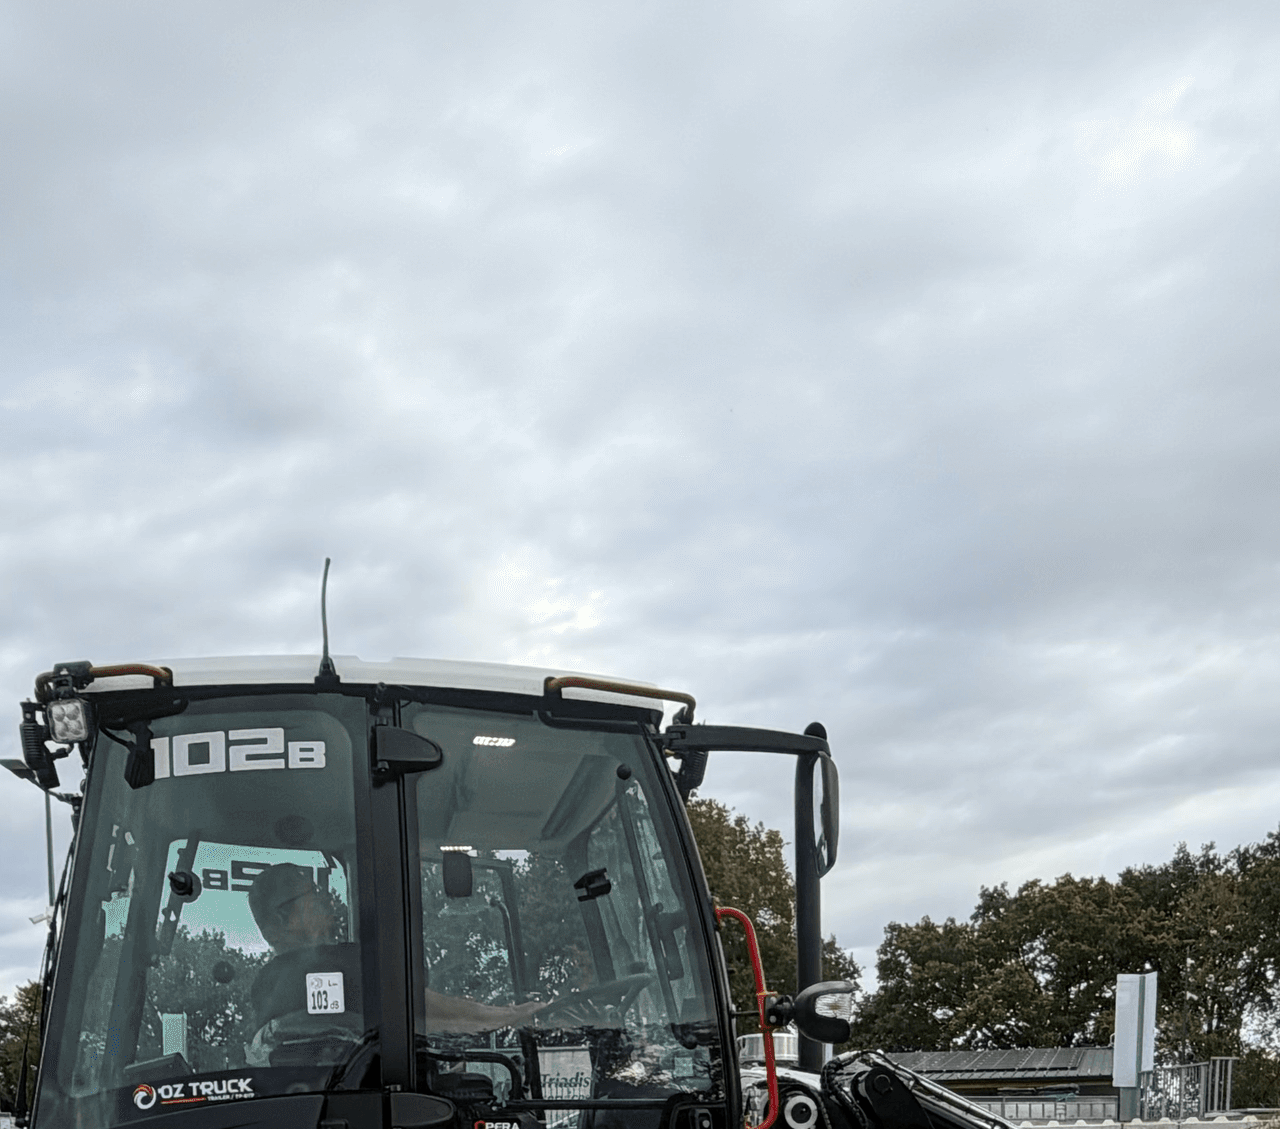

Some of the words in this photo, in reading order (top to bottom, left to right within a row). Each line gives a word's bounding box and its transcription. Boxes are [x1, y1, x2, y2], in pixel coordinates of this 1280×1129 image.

[311, 990, 329, 1010] 103
[188, 1078, 253, 1096] TRUCK
[540, 1071, 591, 1088] Triadis
